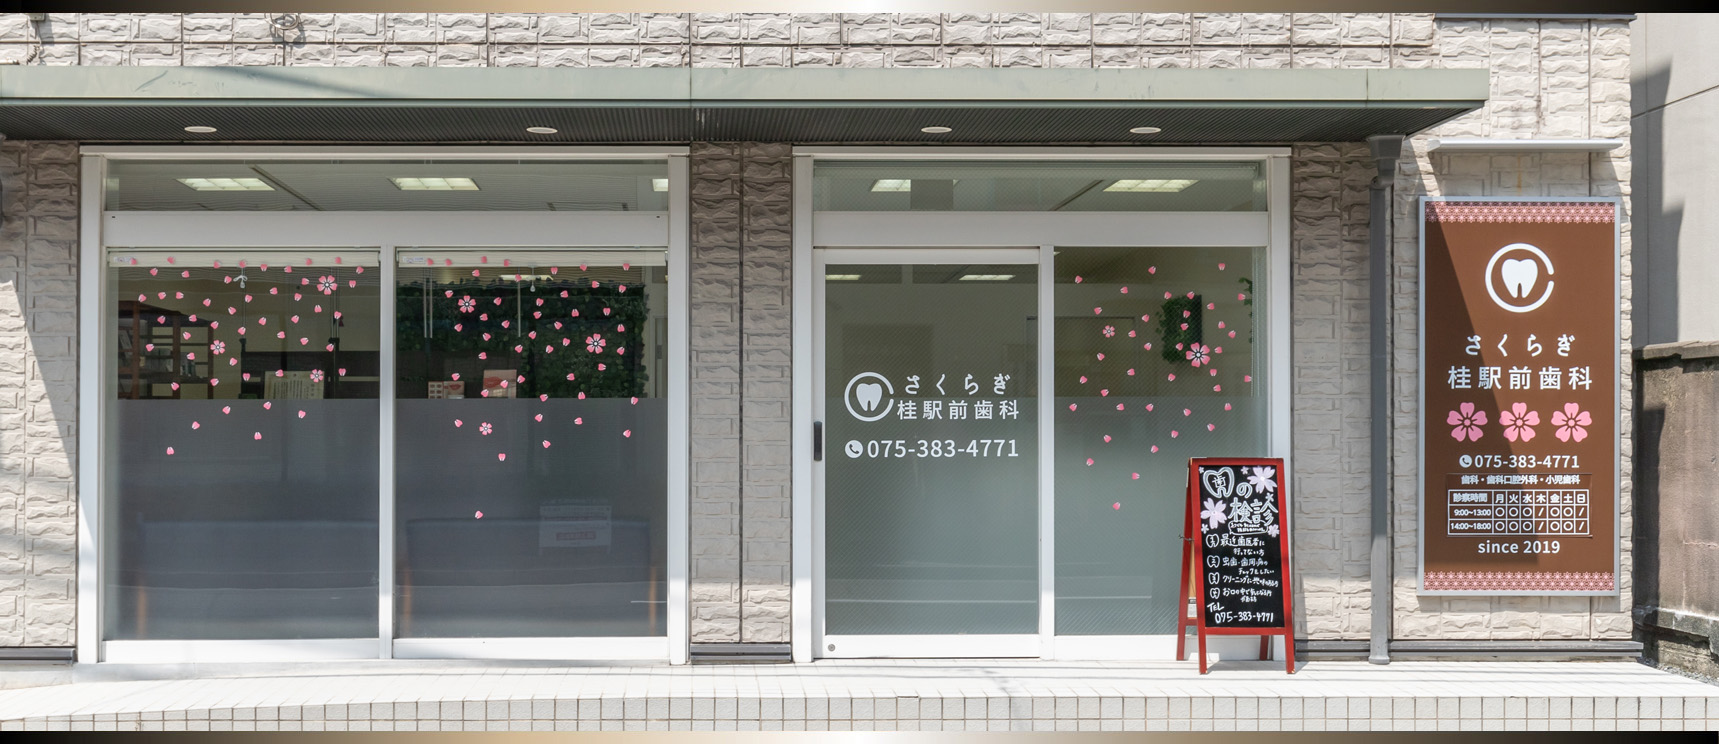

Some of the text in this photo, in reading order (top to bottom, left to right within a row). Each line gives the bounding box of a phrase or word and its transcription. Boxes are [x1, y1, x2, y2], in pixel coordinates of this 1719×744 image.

[1464, 333, 1576, 357] さくらぎ
[904, 373, 1011, 396] さくらぎ
[1447, 365, 1593, 390] 桂駅前歯科
[896, 400, 1020, 421] 桂駅前歯科
[867, 439, 1019, 458] 075-383-4771
[1474, 454, 1580, 468] 075-383-4771
[1453, 493, 1586, 504] 診察時間 月 火 水 木 金 土 日
[1228, 497, 1279, 526] 検診
[1221, 534, 1265, 547] 最近歯医者に
[1478, 540, 1560, 554] since 2019
[1206, 602, 1225, 613] TEL
[1214, 611, 1274, 624] 075-383-4771
